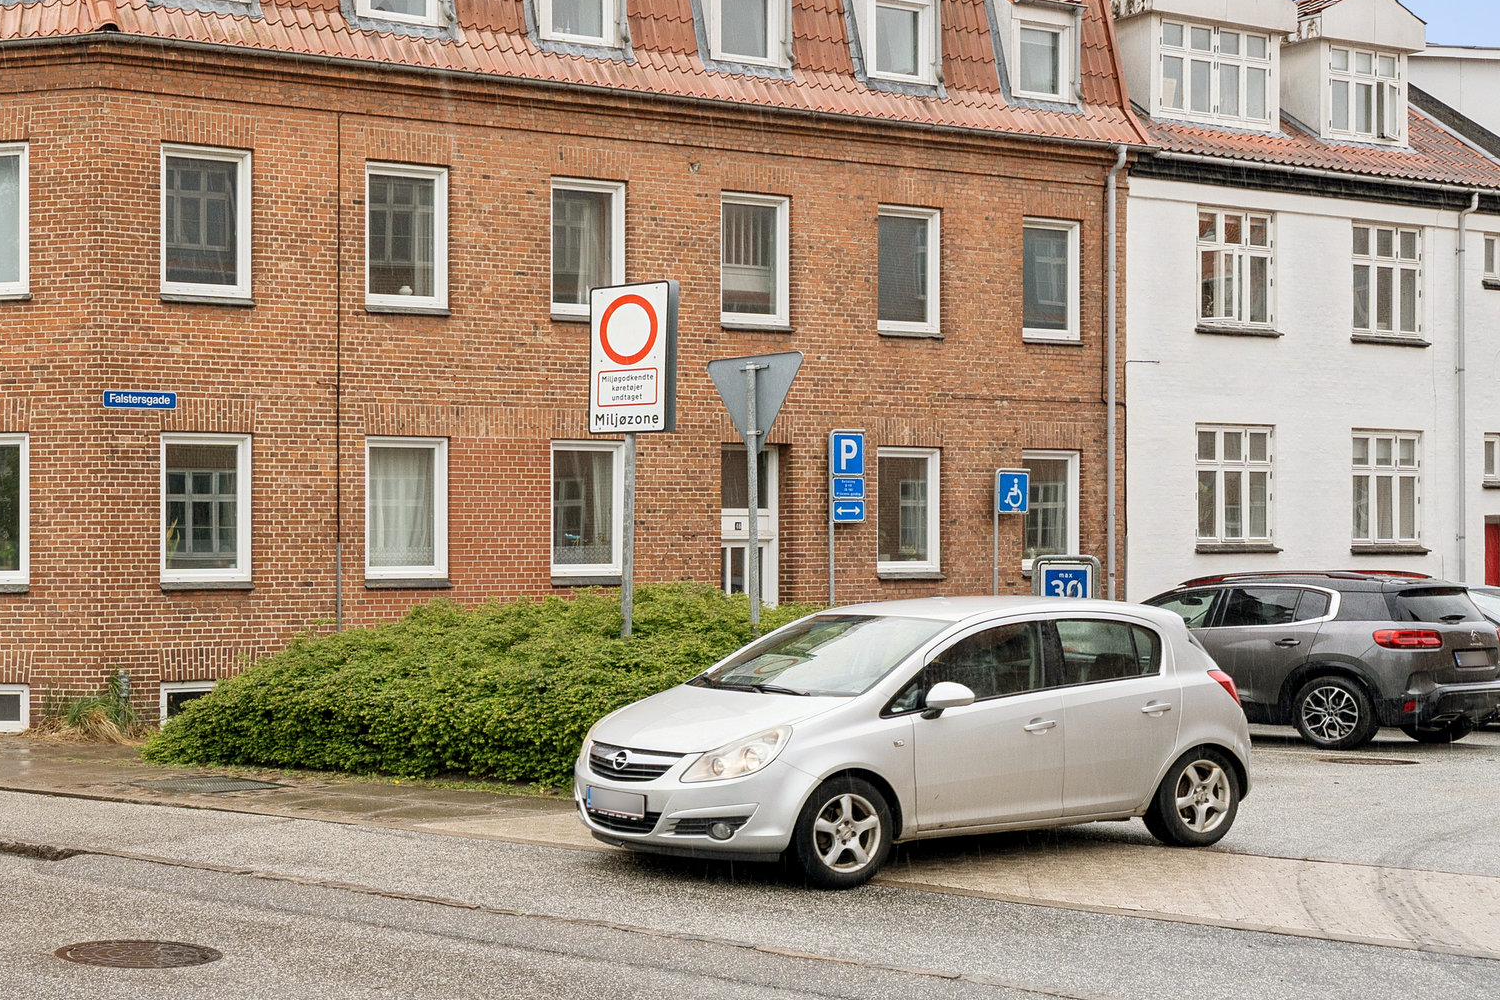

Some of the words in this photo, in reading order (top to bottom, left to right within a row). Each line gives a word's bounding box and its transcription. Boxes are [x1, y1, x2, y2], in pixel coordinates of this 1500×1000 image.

[602, 374, 654, 383] Miljøgodkendte
[611, 384, 644, 392] køretøjer
[109, 393, 171, 406] Falstersgade
[611, 393, 643, 402] undtaget
[595, 413, 659, 428] Miljøzone
[840, 438, 858, 470] P
[1050, 579, 1083, 598] 30
